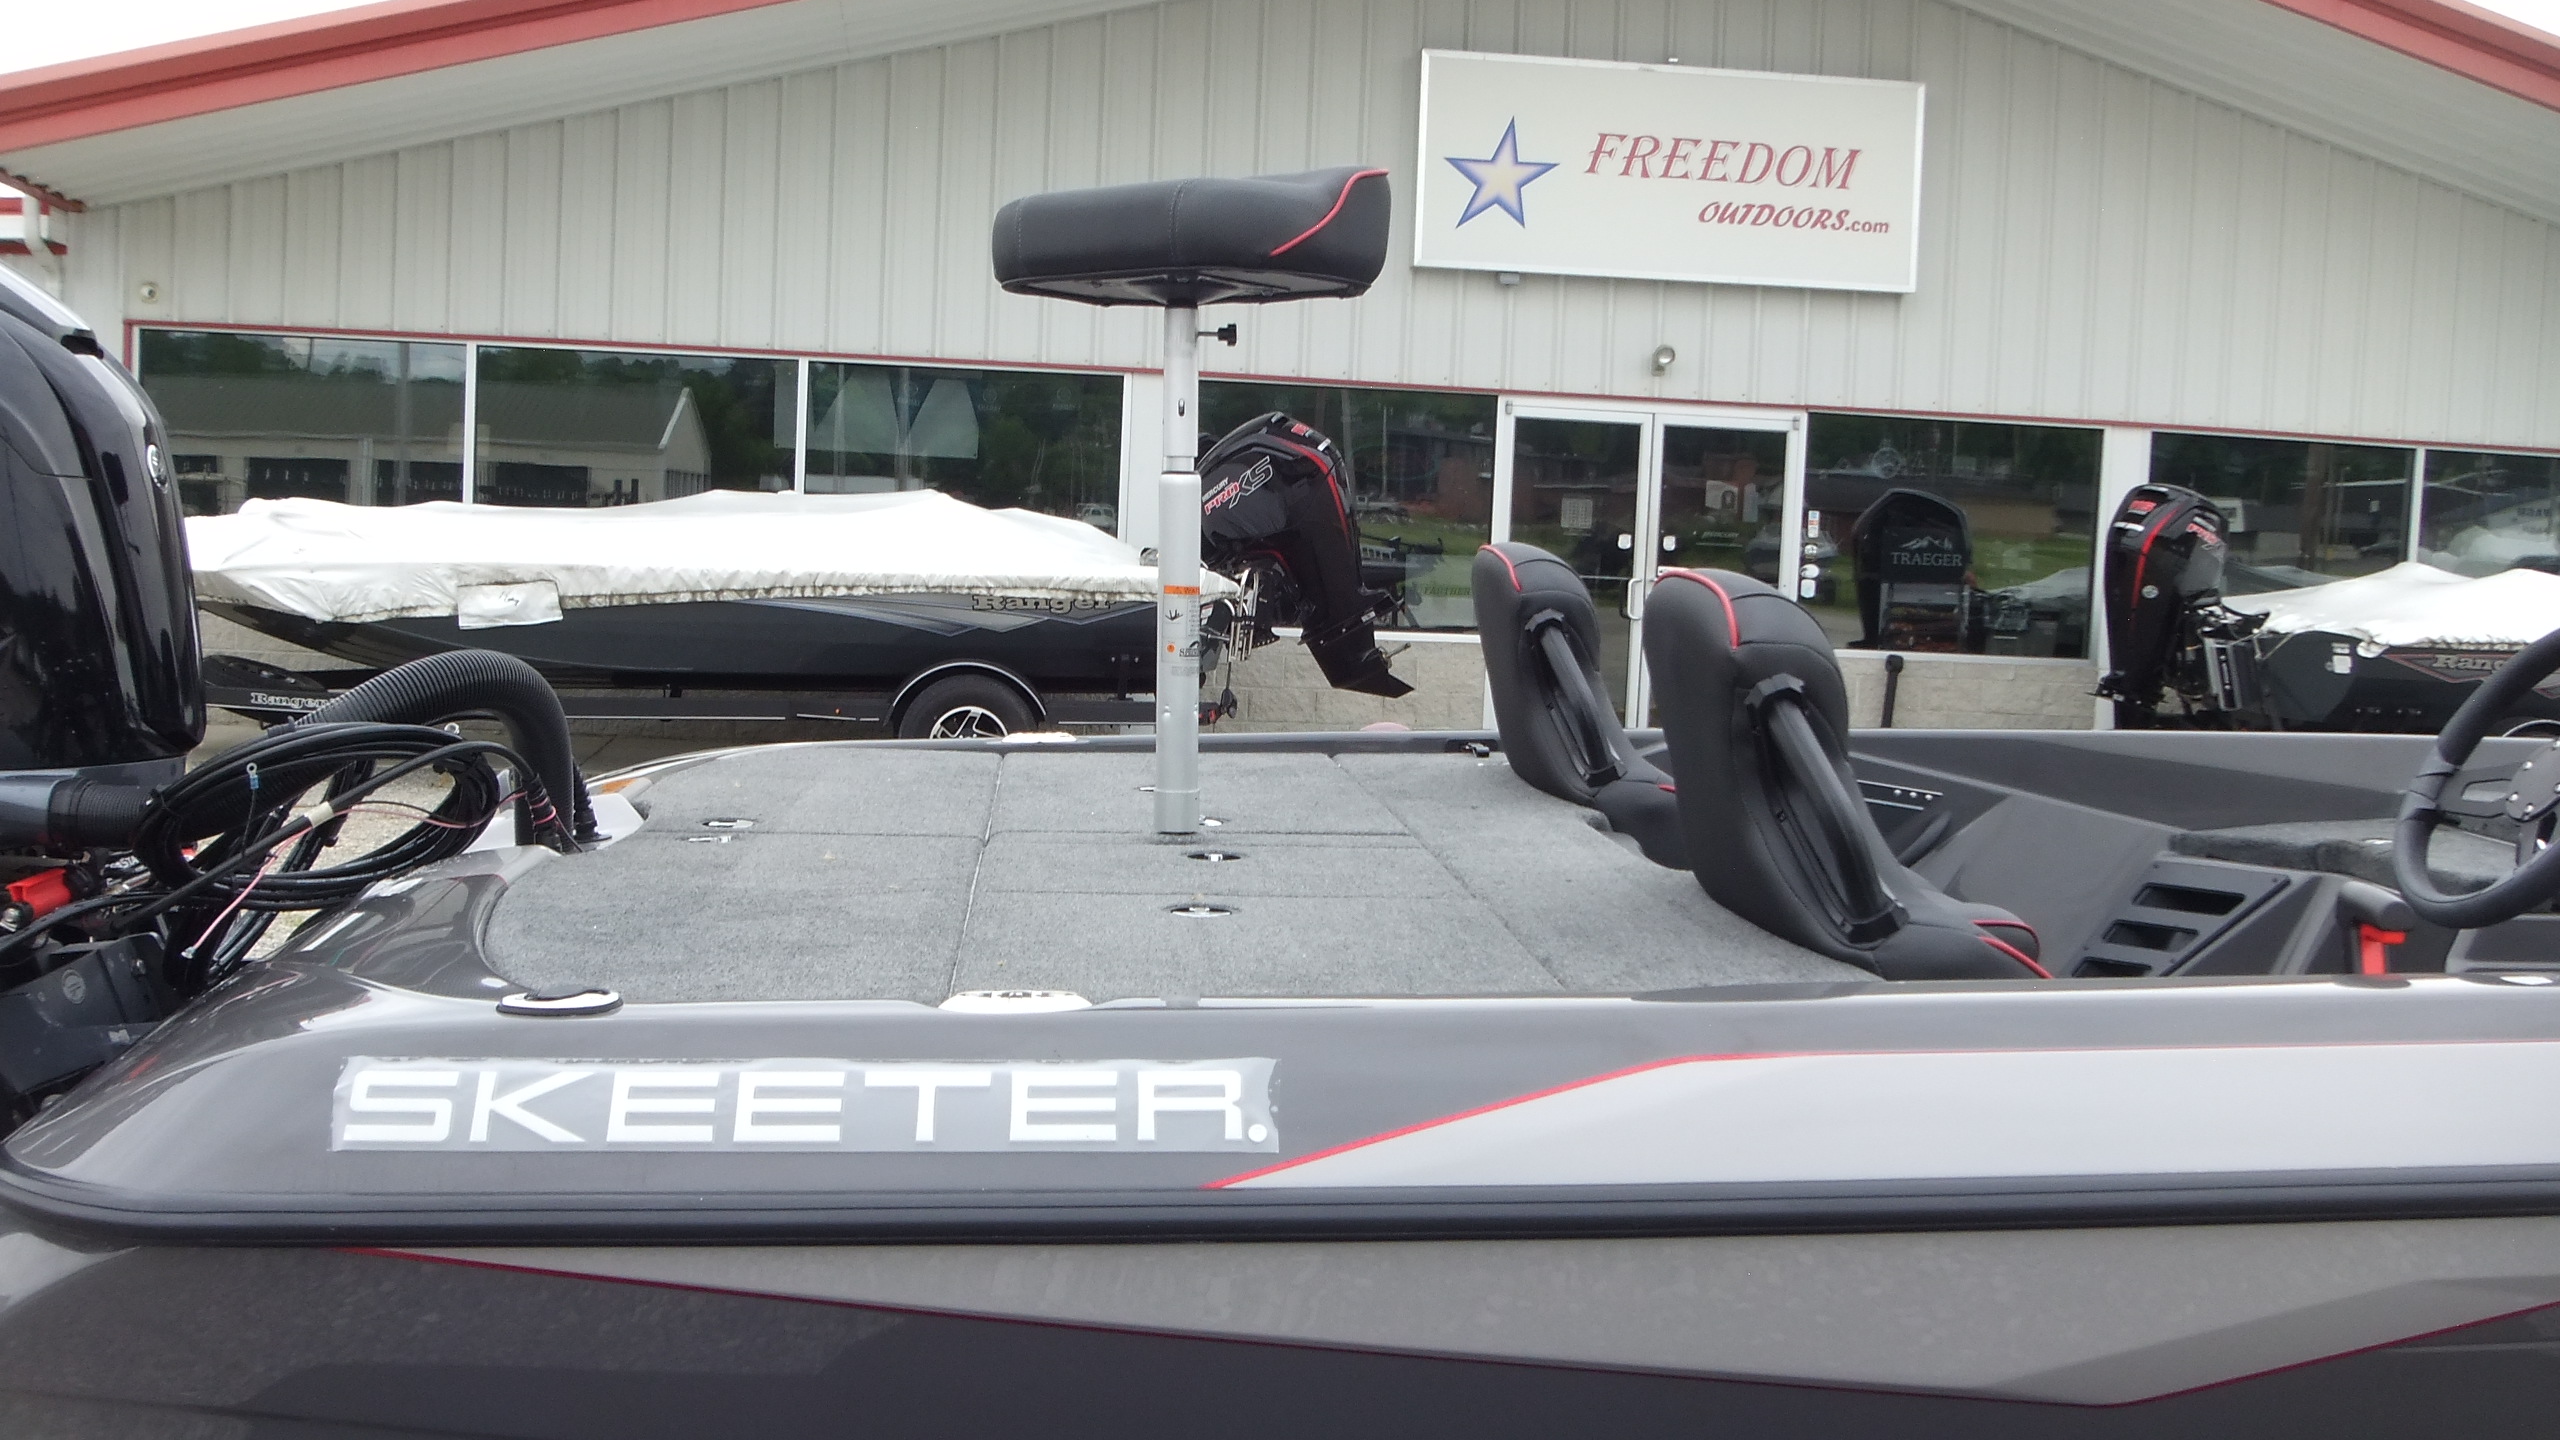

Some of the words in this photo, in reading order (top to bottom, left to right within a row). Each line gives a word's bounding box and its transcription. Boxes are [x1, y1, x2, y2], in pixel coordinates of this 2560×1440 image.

[1584, 132, 1863, 190] FREEDOM
[1698, 201, 1889, 234] OUTDOORS.com
[1892, 551, 1963, 567] TRAEGER
[972, 595, 1117, 614] Ranger
